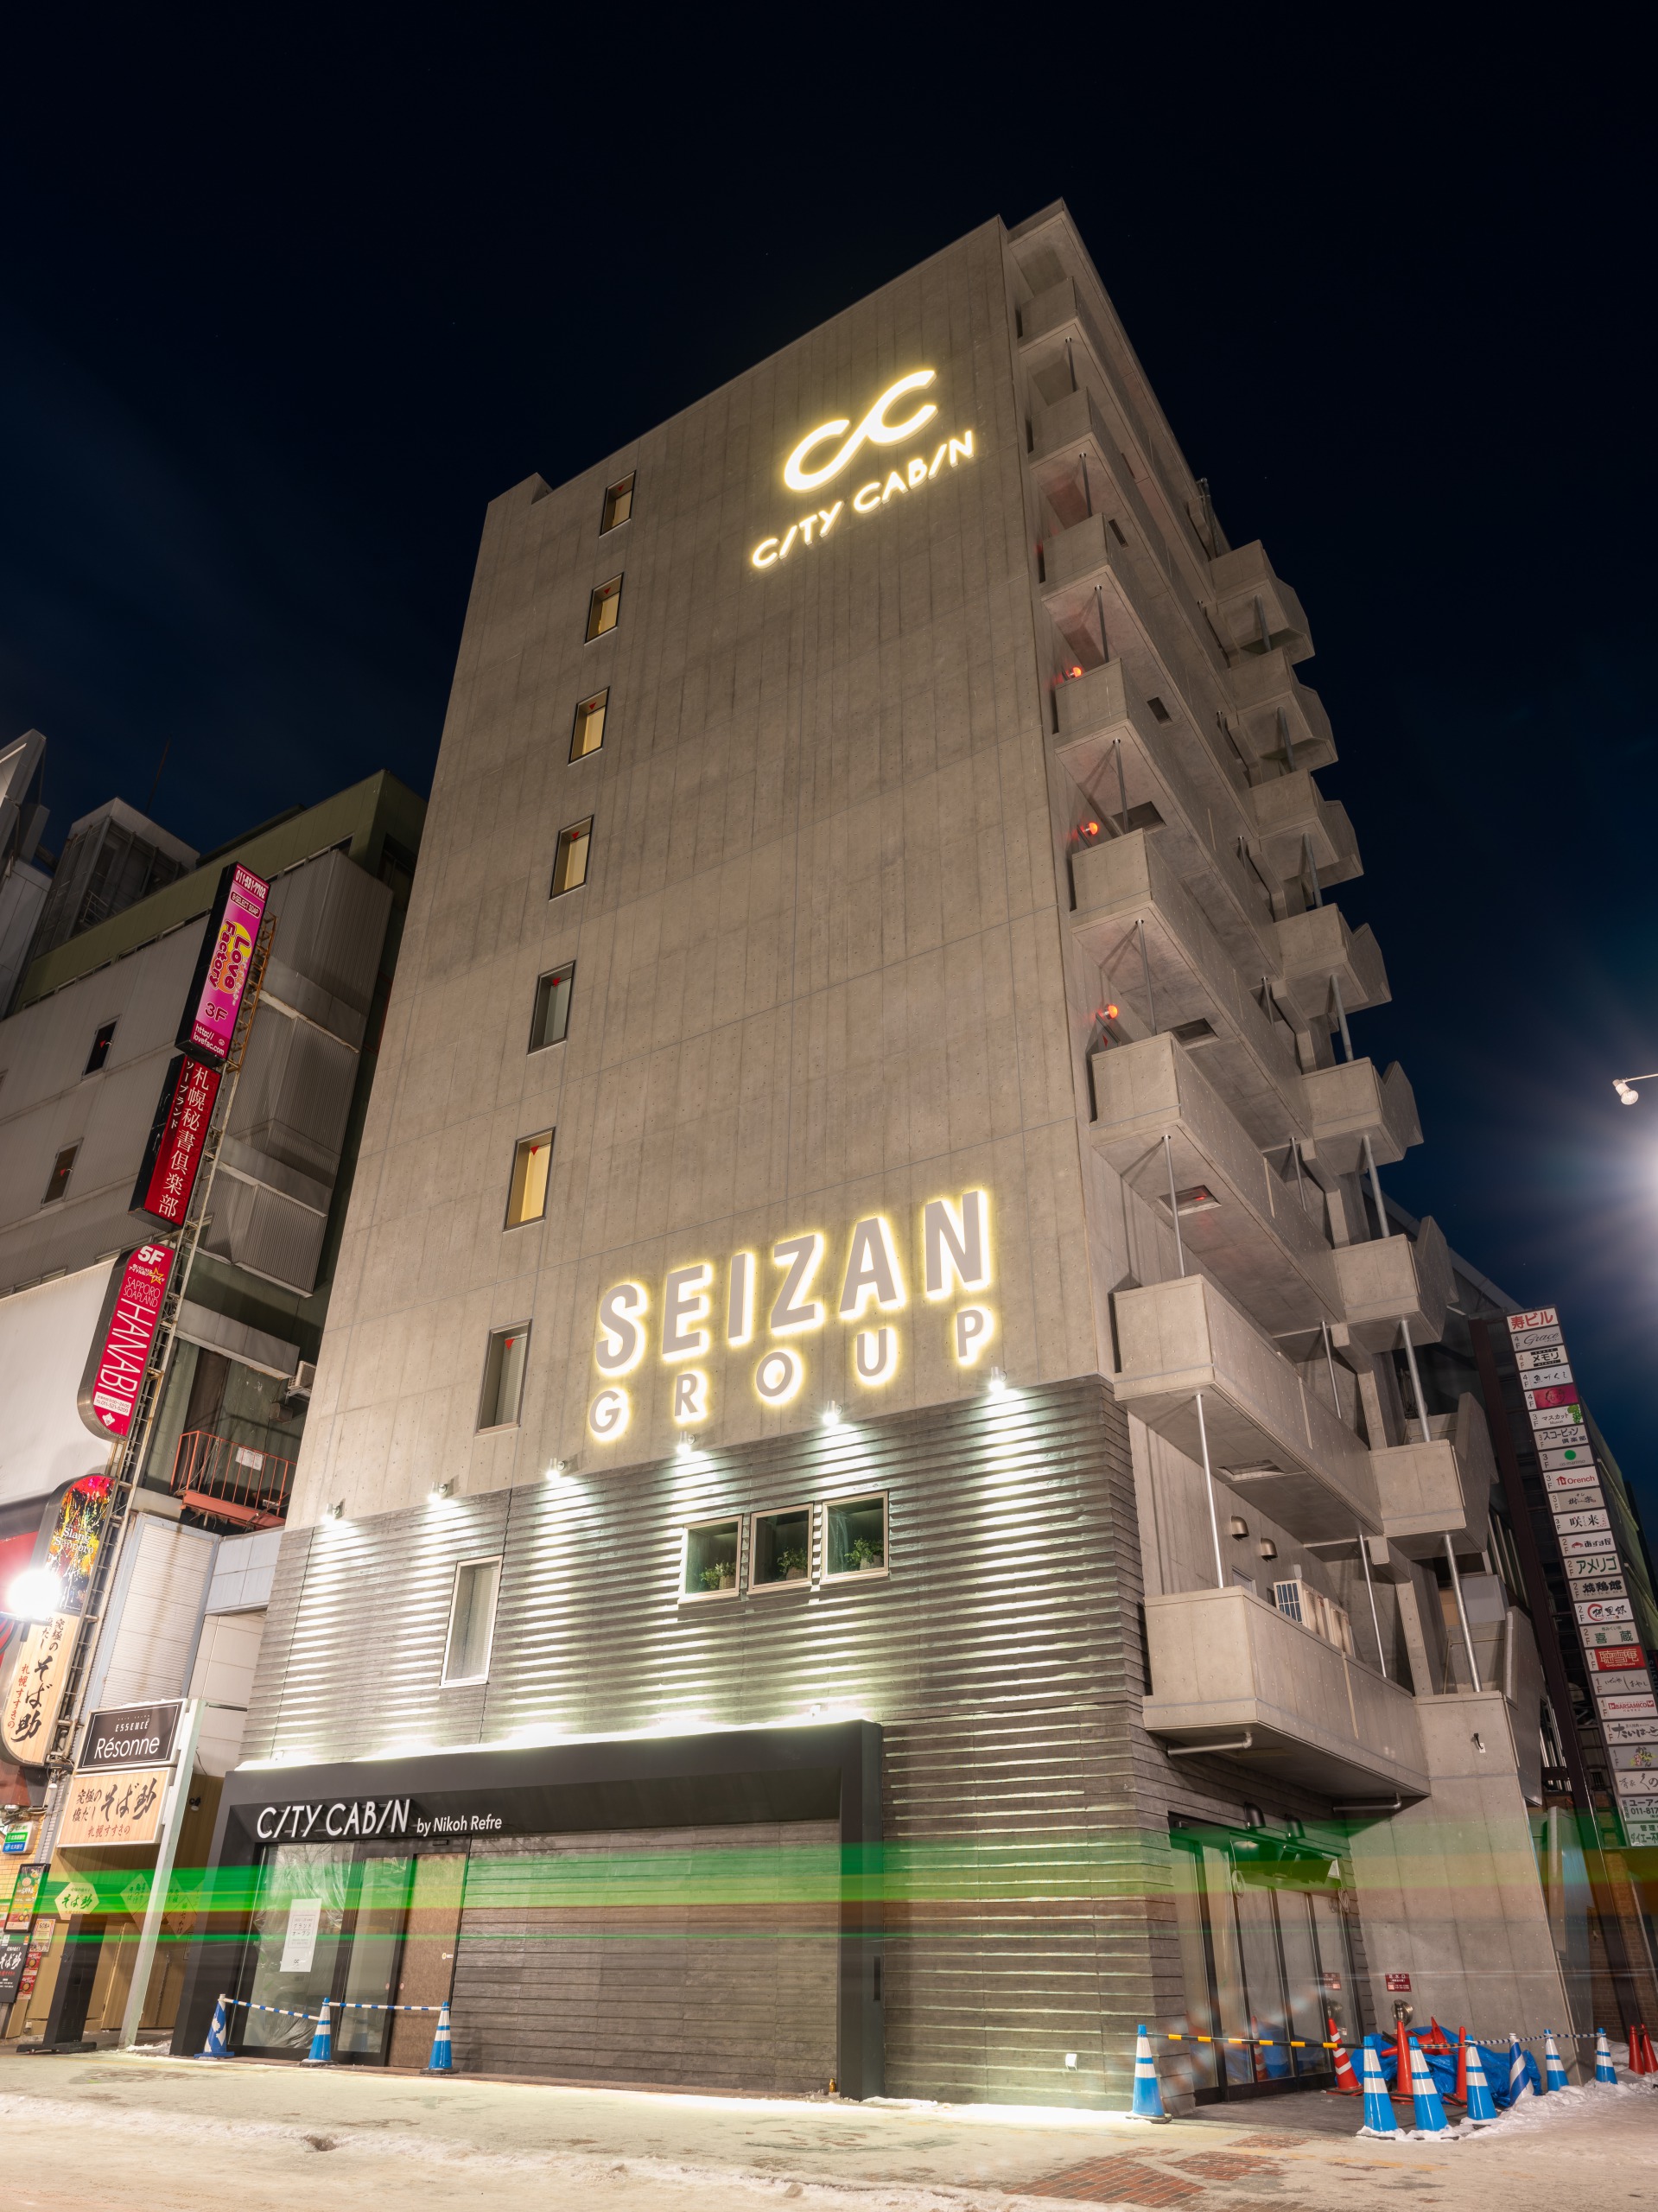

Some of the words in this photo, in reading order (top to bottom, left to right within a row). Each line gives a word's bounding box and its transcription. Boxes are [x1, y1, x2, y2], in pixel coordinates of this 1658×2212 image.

[209, 919, 237, 991] Factory
[224, 934, 251, 990] Love
[205, 1002, 228, 1021] 3F
[193, 1032, 224, 1055] lovefac.com
[171, 1061, 194, 1128] ソープランド
[159, 1067, 209, 1218] 札幌秘書倶楽部
[138, 1245, 165, 1265] 5F
[126, 1277, 161, 1298] SAPPORO
[594, 1190, 989, 1374] SEIZAN
[123, 1286, 159, 1307] SOAPLAND
[1511, 1311, 1553, 1330] 寿ビル
[98, 1298, 156, 1398] HANABI
[1524, 1333, 1559, 1346] Grace
[1533, 1352, 1559, 1363] メモリ
[589, 1307, 990, 1439] GROUP
[1567, 1476, 1595, 1484] Orench
[55, 1536, 94, 1554] Sapporo
[62, 1527, 91, 1545] Slang
[1576, 1556, 1617, 1574] アメリゴ
[7, 1664, 30, 1729] 札幌すすきの
[11, 1656, 53, 1742] そば助
[94, 1737, 160, 1759] Résonne
[78, 1789, 102, 1805] 究極の
[101, 1777, 157, 1822] そば助
[72, 1806, 96, 1822] 塩だし
[257, 1804, 323, 1839] CITY
[326, 1799, 412, 1837] CABIN
[416, 1818, 431, 1837] by
[433, 1815, 467, 1833] Nikoh
[470, 1813, 502, 1831] Refre
[87, 1824, 130, 1838] 札幌すすきの
[62, 1893, 92, 1909] そば助
